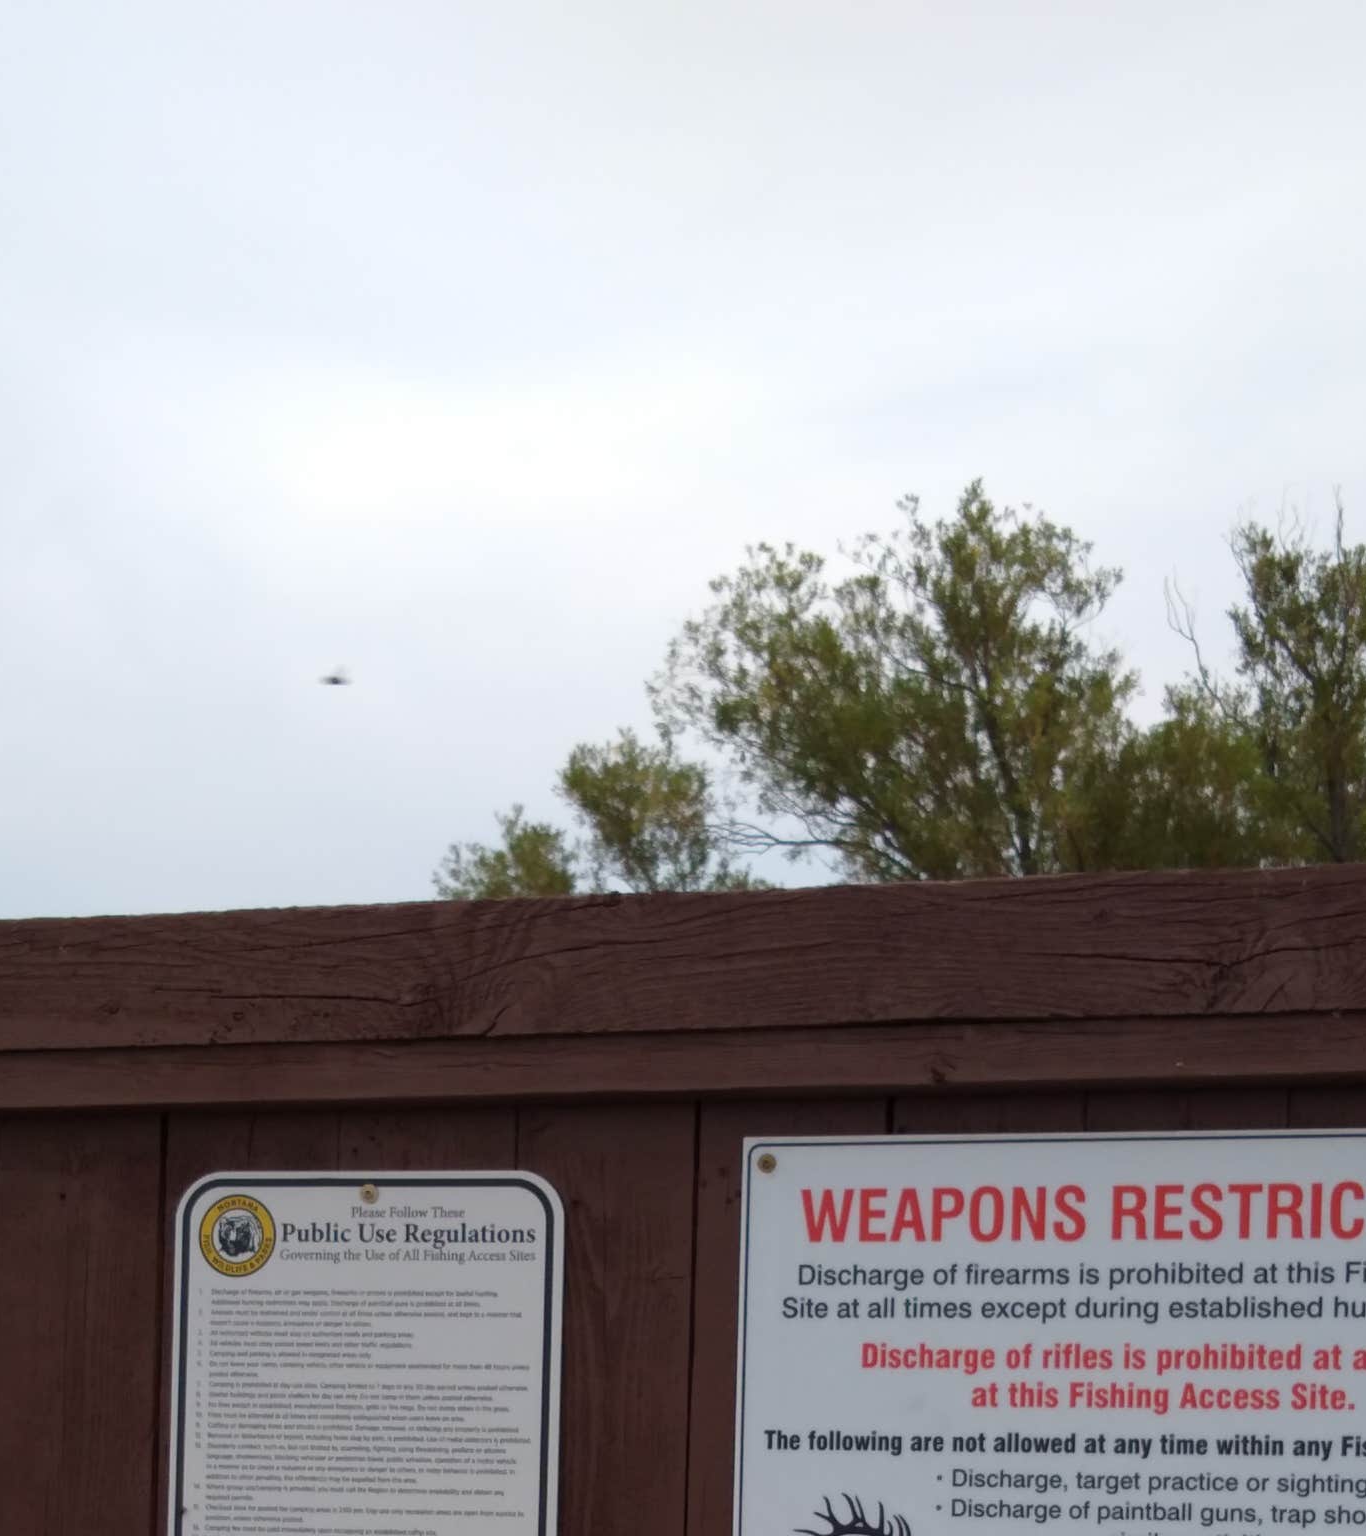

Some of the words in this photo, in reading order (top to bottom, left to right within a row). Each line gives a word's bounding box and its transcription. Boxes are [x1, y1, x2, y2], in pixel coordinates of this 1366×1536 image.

[351, 1206, 386, 1218] Please
[389, 1206, 428, 1218] Follow
[431, 1206, 465, 1218] These
[801, 1185, 1086, 1242] WEAPONS
[281, 1223, 350, 1242] Public
[358, 1223, 396, 1243] Use
[404, 1223, 535, 1248] Regulations
[279, 1249, 340, 1264] Governing
[343, 1249, 361, 1260] the
[365, 1249, 385, 1261] Use
[388, 1249, 401, 1261] of
[402, 1249, 419, 1261] All
[423, 1249, 465, 1264] Fishing
[467, 1250, 506, 1261] Access
[509, 1249, 536, 1261] Sites
[798, 1264, 924, 1291] Discharge
[933, 1263, 957, 1285] of
[965, 1263, 1069, 1285] firearms
[1079, 1263, 1099, 1284] is
[1109, 1262, 1243, 1290] prohibited
[1253, 1263, 1277, 1284] at
[1286, 1261, 1335, 1284] this
[782, 1296, 828, 1318] Site
[837, 1298, 859, 1318] at
[867, 1297, 894, 1318] all
[903, 1297, 971, 1318] times
[981, 1298, 1066, 1324] except
[1075, 1296, 1158, 1324] during
[1168, 1296, 1322, 1318] established
[862, 1342, 995, 1375] Discharge
[1006, 1343, 1032, 1369] of
[1042, 1343, 1112, 1369] rifles
[1124, 1343, 1145, 1370] is
[1157, 1343, 1301, 1375] prohibited
[1313, 1344, 1342, 1370] at
[971, 1382, 998, 1407] at
[1008, 1382, 1058, 1408] this
[1069, 1382, 1169, 1414] Fishing
[1179, 1382, 1280, 1409] Access
[1291, 1382, 1354, 1410] Site.
[764, 1430, 800, 1450] The
[808, 1430, 902, 1456] following
[910, 1436, 943, 1452] are
[952, 1433, 985, 1452] not
[993, 1432, 1075, 1453] allowed
[1084, 1434, 1106, 1454] at
[1113, 1438, 1152, 1459] any
[1159, 1434, 1207, 1455] time
[1216, 1434, 1283, 1456] within
[1292, 1440, 1332, 1461] any
[952, 1468, 1067, 1493] Discharge,
[1076, 1472, 1140, 1494] target
[1148, 1472, 1238, 1495] practice
[1246, 1477, 1269, 1492] or
[951, 1498, 1061, 1523] Discharge
[1069, 1500, 1090, 1519] of
[1097, 1502, 1192, 1524] paintball
[1200, 1507, 1262, 1527] guns,
[1270, 1505, 1315, 1528] trap
